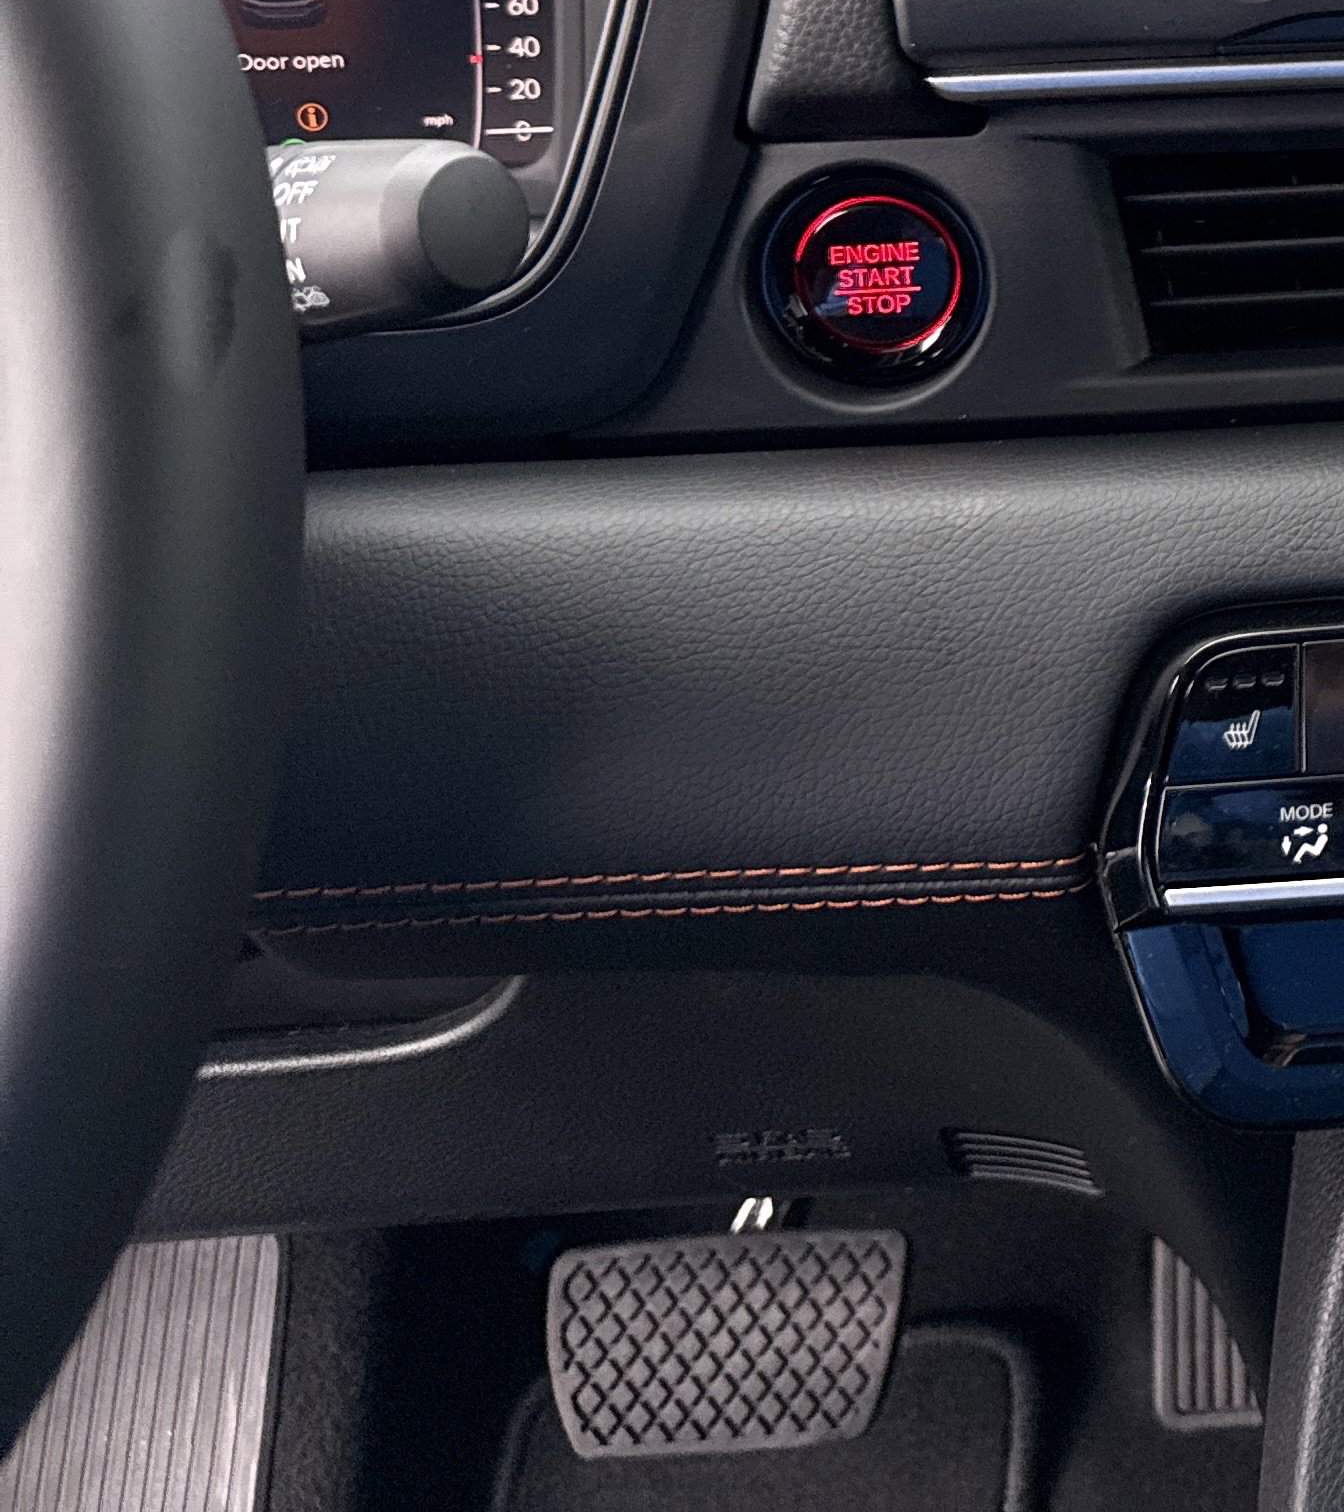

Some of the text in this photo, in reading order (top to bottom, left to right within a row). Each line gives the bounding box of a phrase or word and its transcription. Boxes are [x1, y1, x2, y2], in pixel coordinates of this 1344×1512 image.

[507, 35, 540, 58] 40
[237, 53, 345, 72] Door open
[509, 78, 541, 100] 20
[422, 114, 454, 128] mph
[829, 241, 920, 266] ENGINE
[837, 266, 914, 287] START
[847, 294, 912, 316] STOP
[1280, 802, 1333, 822] MODE
